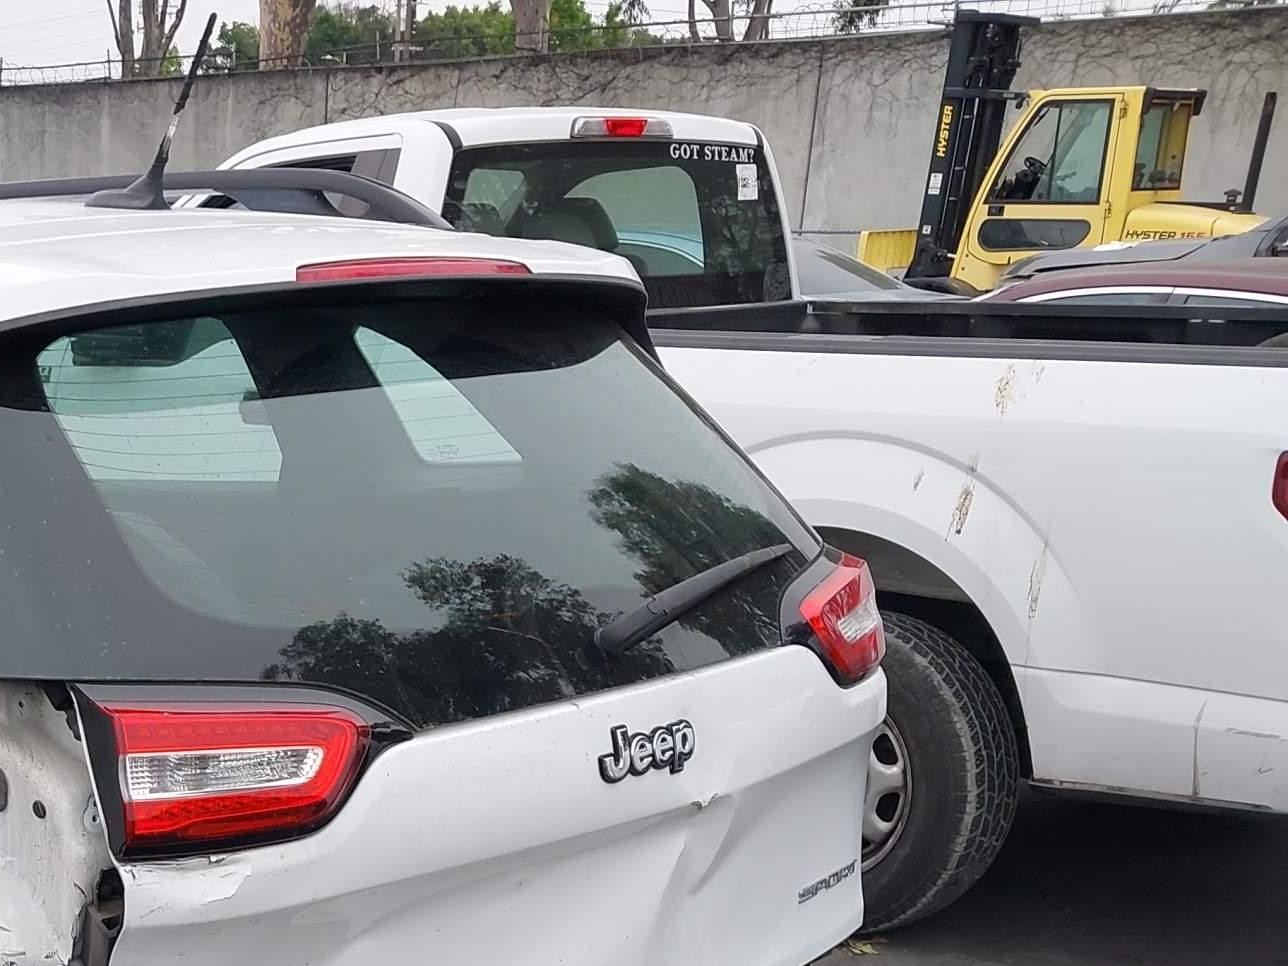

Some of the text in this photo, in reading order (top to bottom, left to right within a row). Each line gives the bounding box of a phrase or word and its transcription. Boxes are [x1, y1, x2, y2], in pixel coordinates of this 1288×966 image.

[936, 105, 954, 158] HYSTER
[670, 143, 755, 163] GOT STEAM?
[1125, 229, 1177, 240] HYSTER
[598, 719, 696, 784] Jeep
